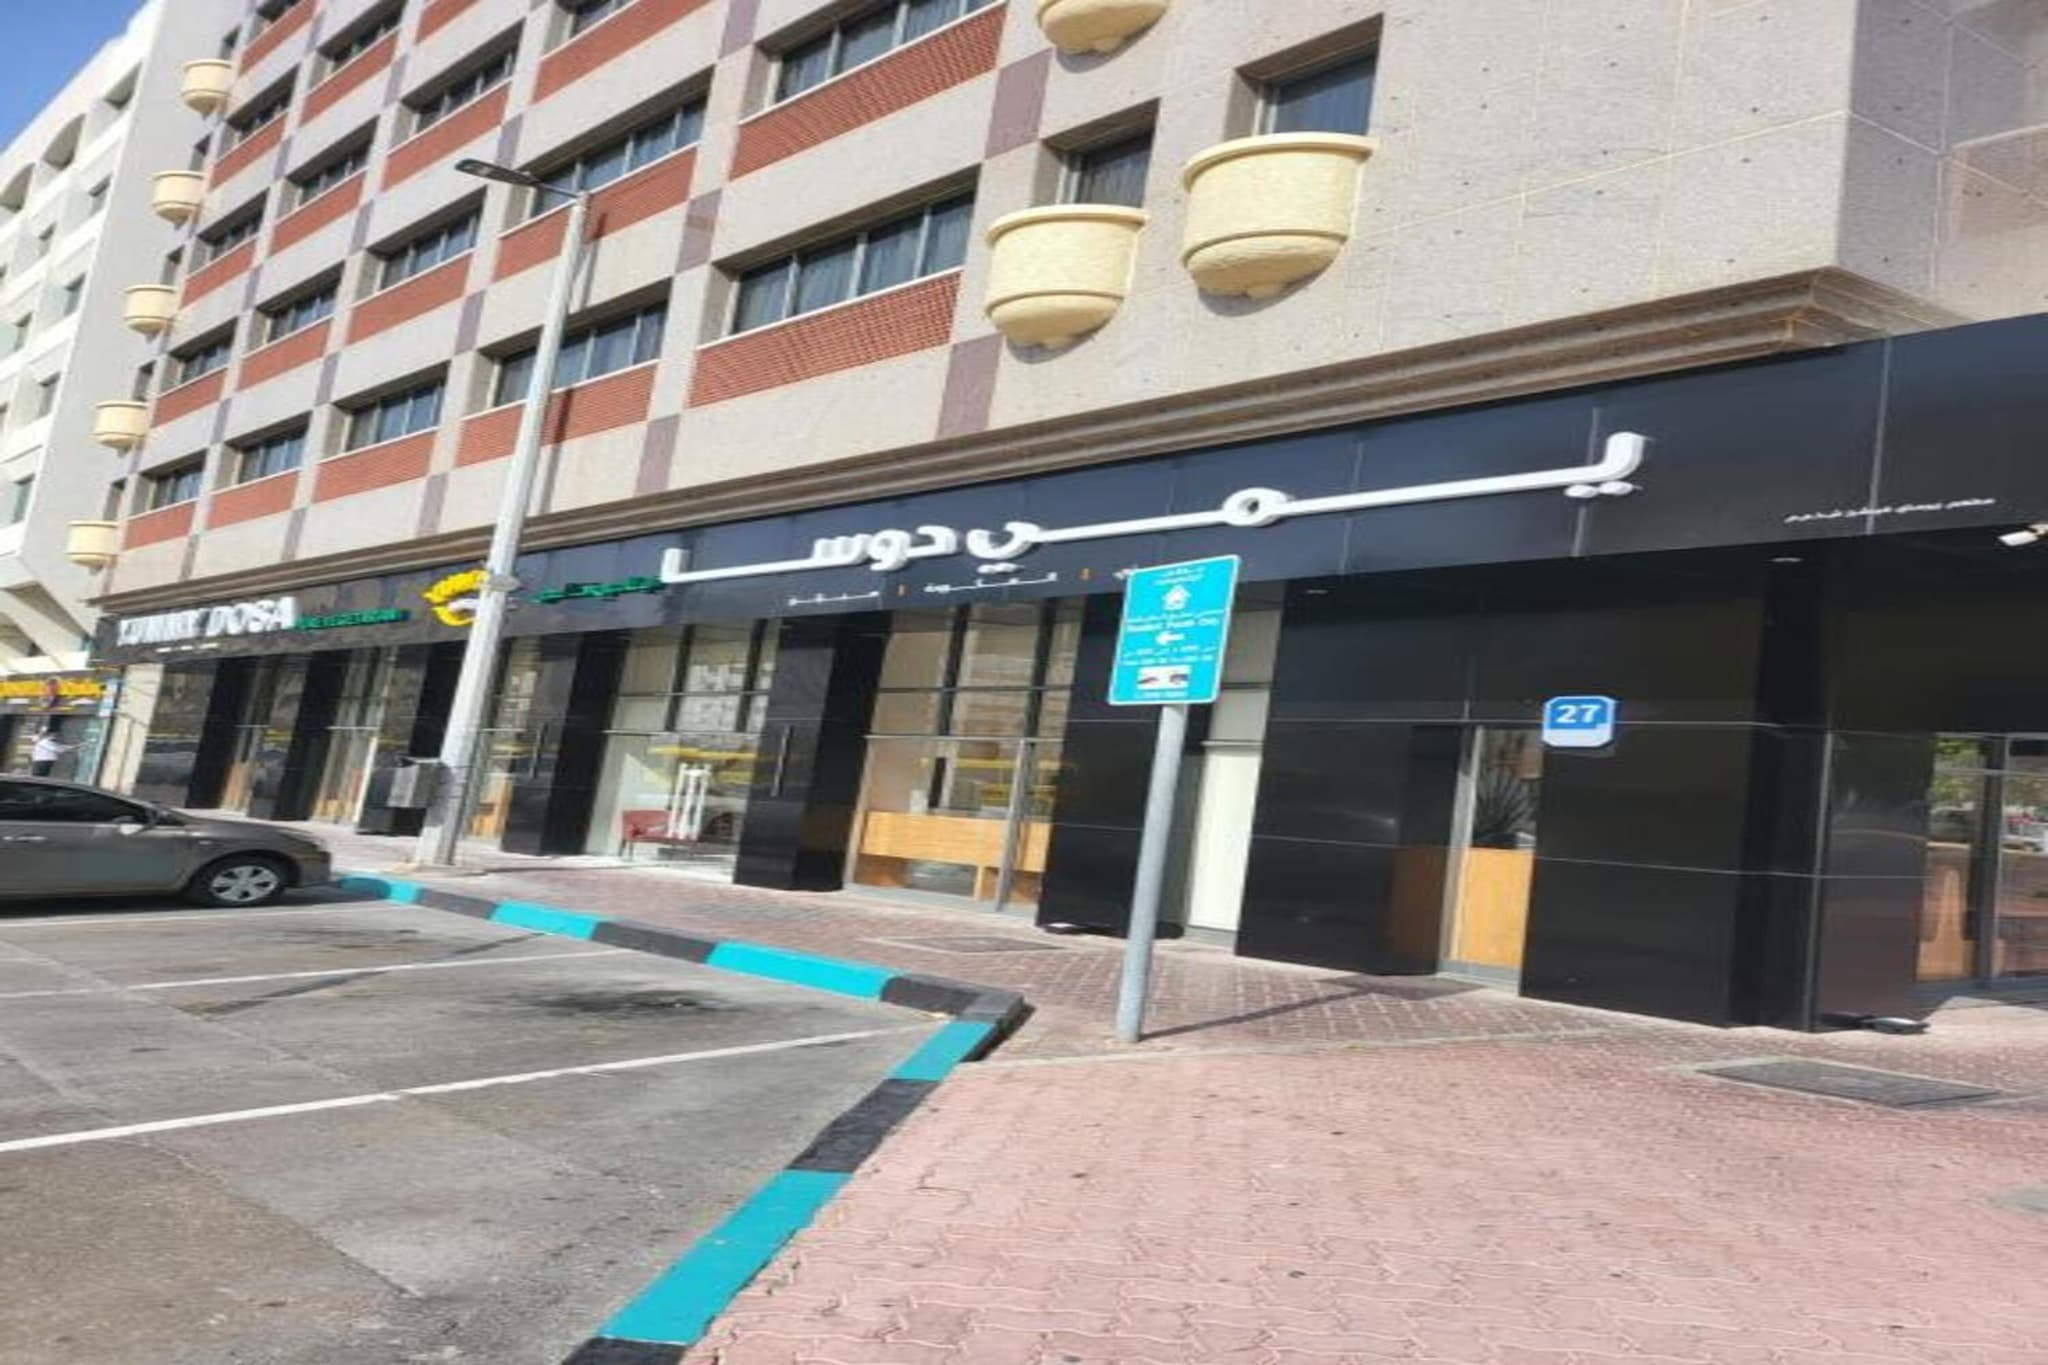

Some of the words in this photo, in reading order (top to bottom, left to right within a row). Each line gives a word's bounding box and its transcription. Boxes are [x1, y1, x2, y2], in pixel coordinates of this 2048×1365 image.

[661, 524, 957, 584] دوسا
[205, 596, 296, 636] DOSA
[1556, 705, 1601, 723] 27
